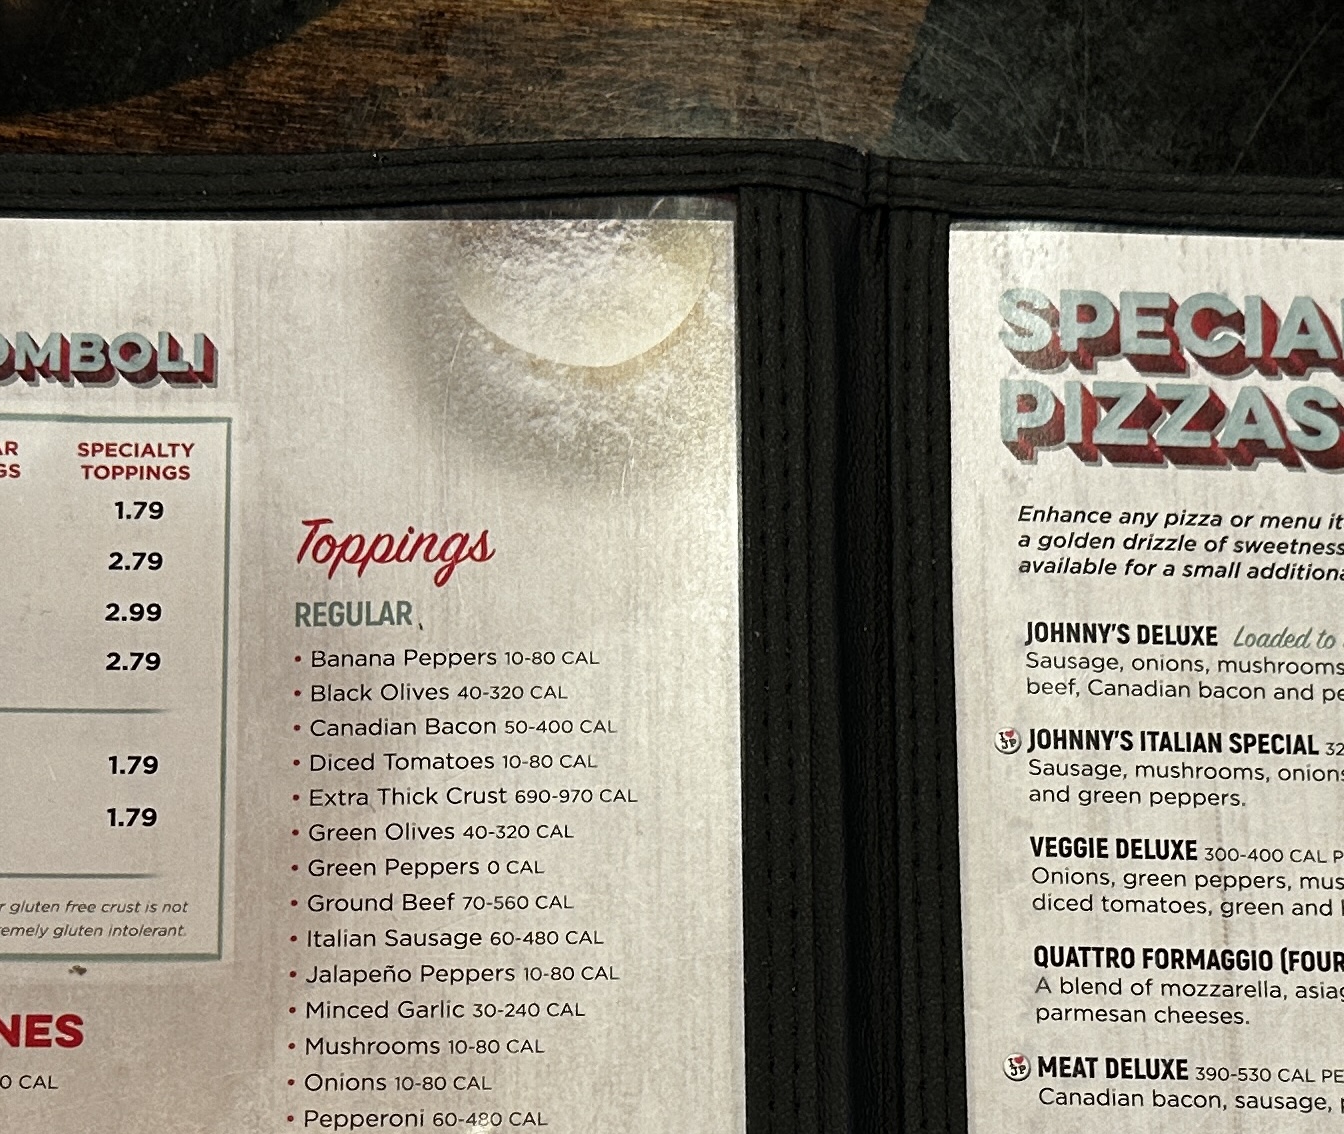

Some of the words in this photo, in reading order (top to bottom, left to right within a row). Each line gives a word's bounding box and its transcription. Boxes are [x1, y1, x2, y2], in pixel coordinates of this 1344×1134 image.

[78, 443, 194, 458] SPECIALTY
[81, 465, 190, 480] TOPPINGS
[115, 501, 163, 519] 1.79
[297, 518, 496, 587] Toppings
[295, 600, 412, 627] REGULAR
[1025, 622, 1130, 646] JOHNNY'S
[1137, 624, 1218, 646] DELUXE
[1233, 626, 1309, 650] Loaded
[1315, 629, 1337, 650] to
[312, 651, 394, 667] Banana
[405, 649, 496, 669] Peppers
[505, 652, 555, 665] 10-80
[562, 651, 599, 664] CAL
[10, 901, 59, 914] gluten
[66, 900, 96, 913] free
[101, 902, 141, 913] crust
[145, 904, 157, 912] is
[162, 902, 188, 913] not
[1034, 946, 1135, 968] QUATTRO
[1143, 948, 1273, 971] FORMAGGIO
[306, 965, 411, 986] Jalapeño
[421, 965, 515, 985] Peppers
[524, 967, 574, 981] 10-80
[581, 966, 619, 980] CAL
